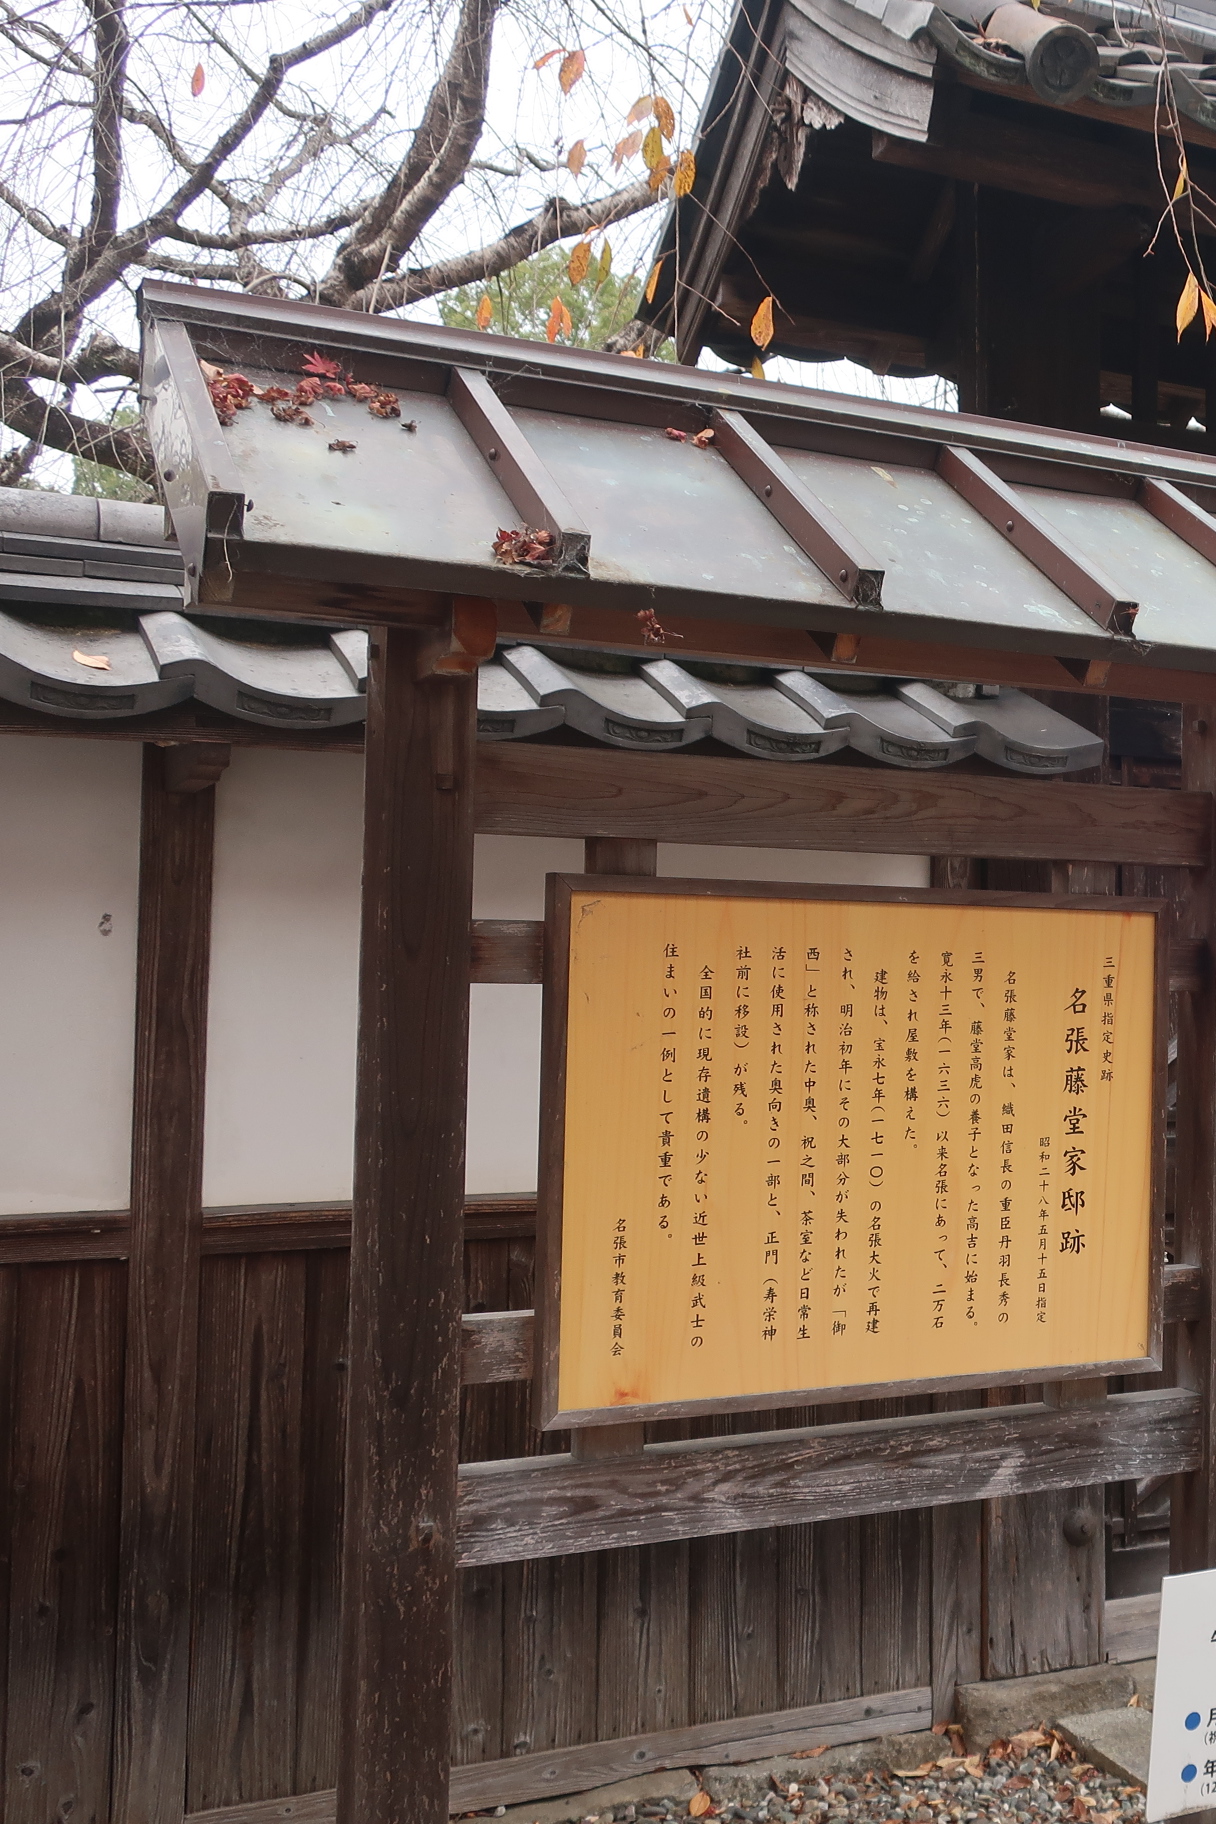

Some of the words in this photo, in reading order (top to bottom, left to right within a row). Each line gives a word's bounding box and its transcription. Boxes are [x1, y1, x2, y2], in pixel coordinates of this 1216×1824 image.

[657, 942, 680, 1240] 住まいの一例として貴重である。
[731, 945, 753, 1126] 社前に移設）が残る。
[903, 950, 921, 1150] を給され屋敷を構えた。
[1059, 987, 1090, 1255] 名張藤堂家邸跡
[1100, 956, 1116, 1082] 三重県指定史跡
[690, 964, 716, 1348] 全国的に現存遺構の少ない近世上級武士の
[964, 951, 986, 1327] 三男で、藤堂高虎の養子となった高吉に始まる。
[997, 970, 1018, 1324] 名張藤堂家は、織田信長の重臣丹羽長秀の
[1035, 1136, 1051, 1324] 昭和二十八年五月十五日指定
[609, 1217, 628, 1358] 名張市教育委員会
